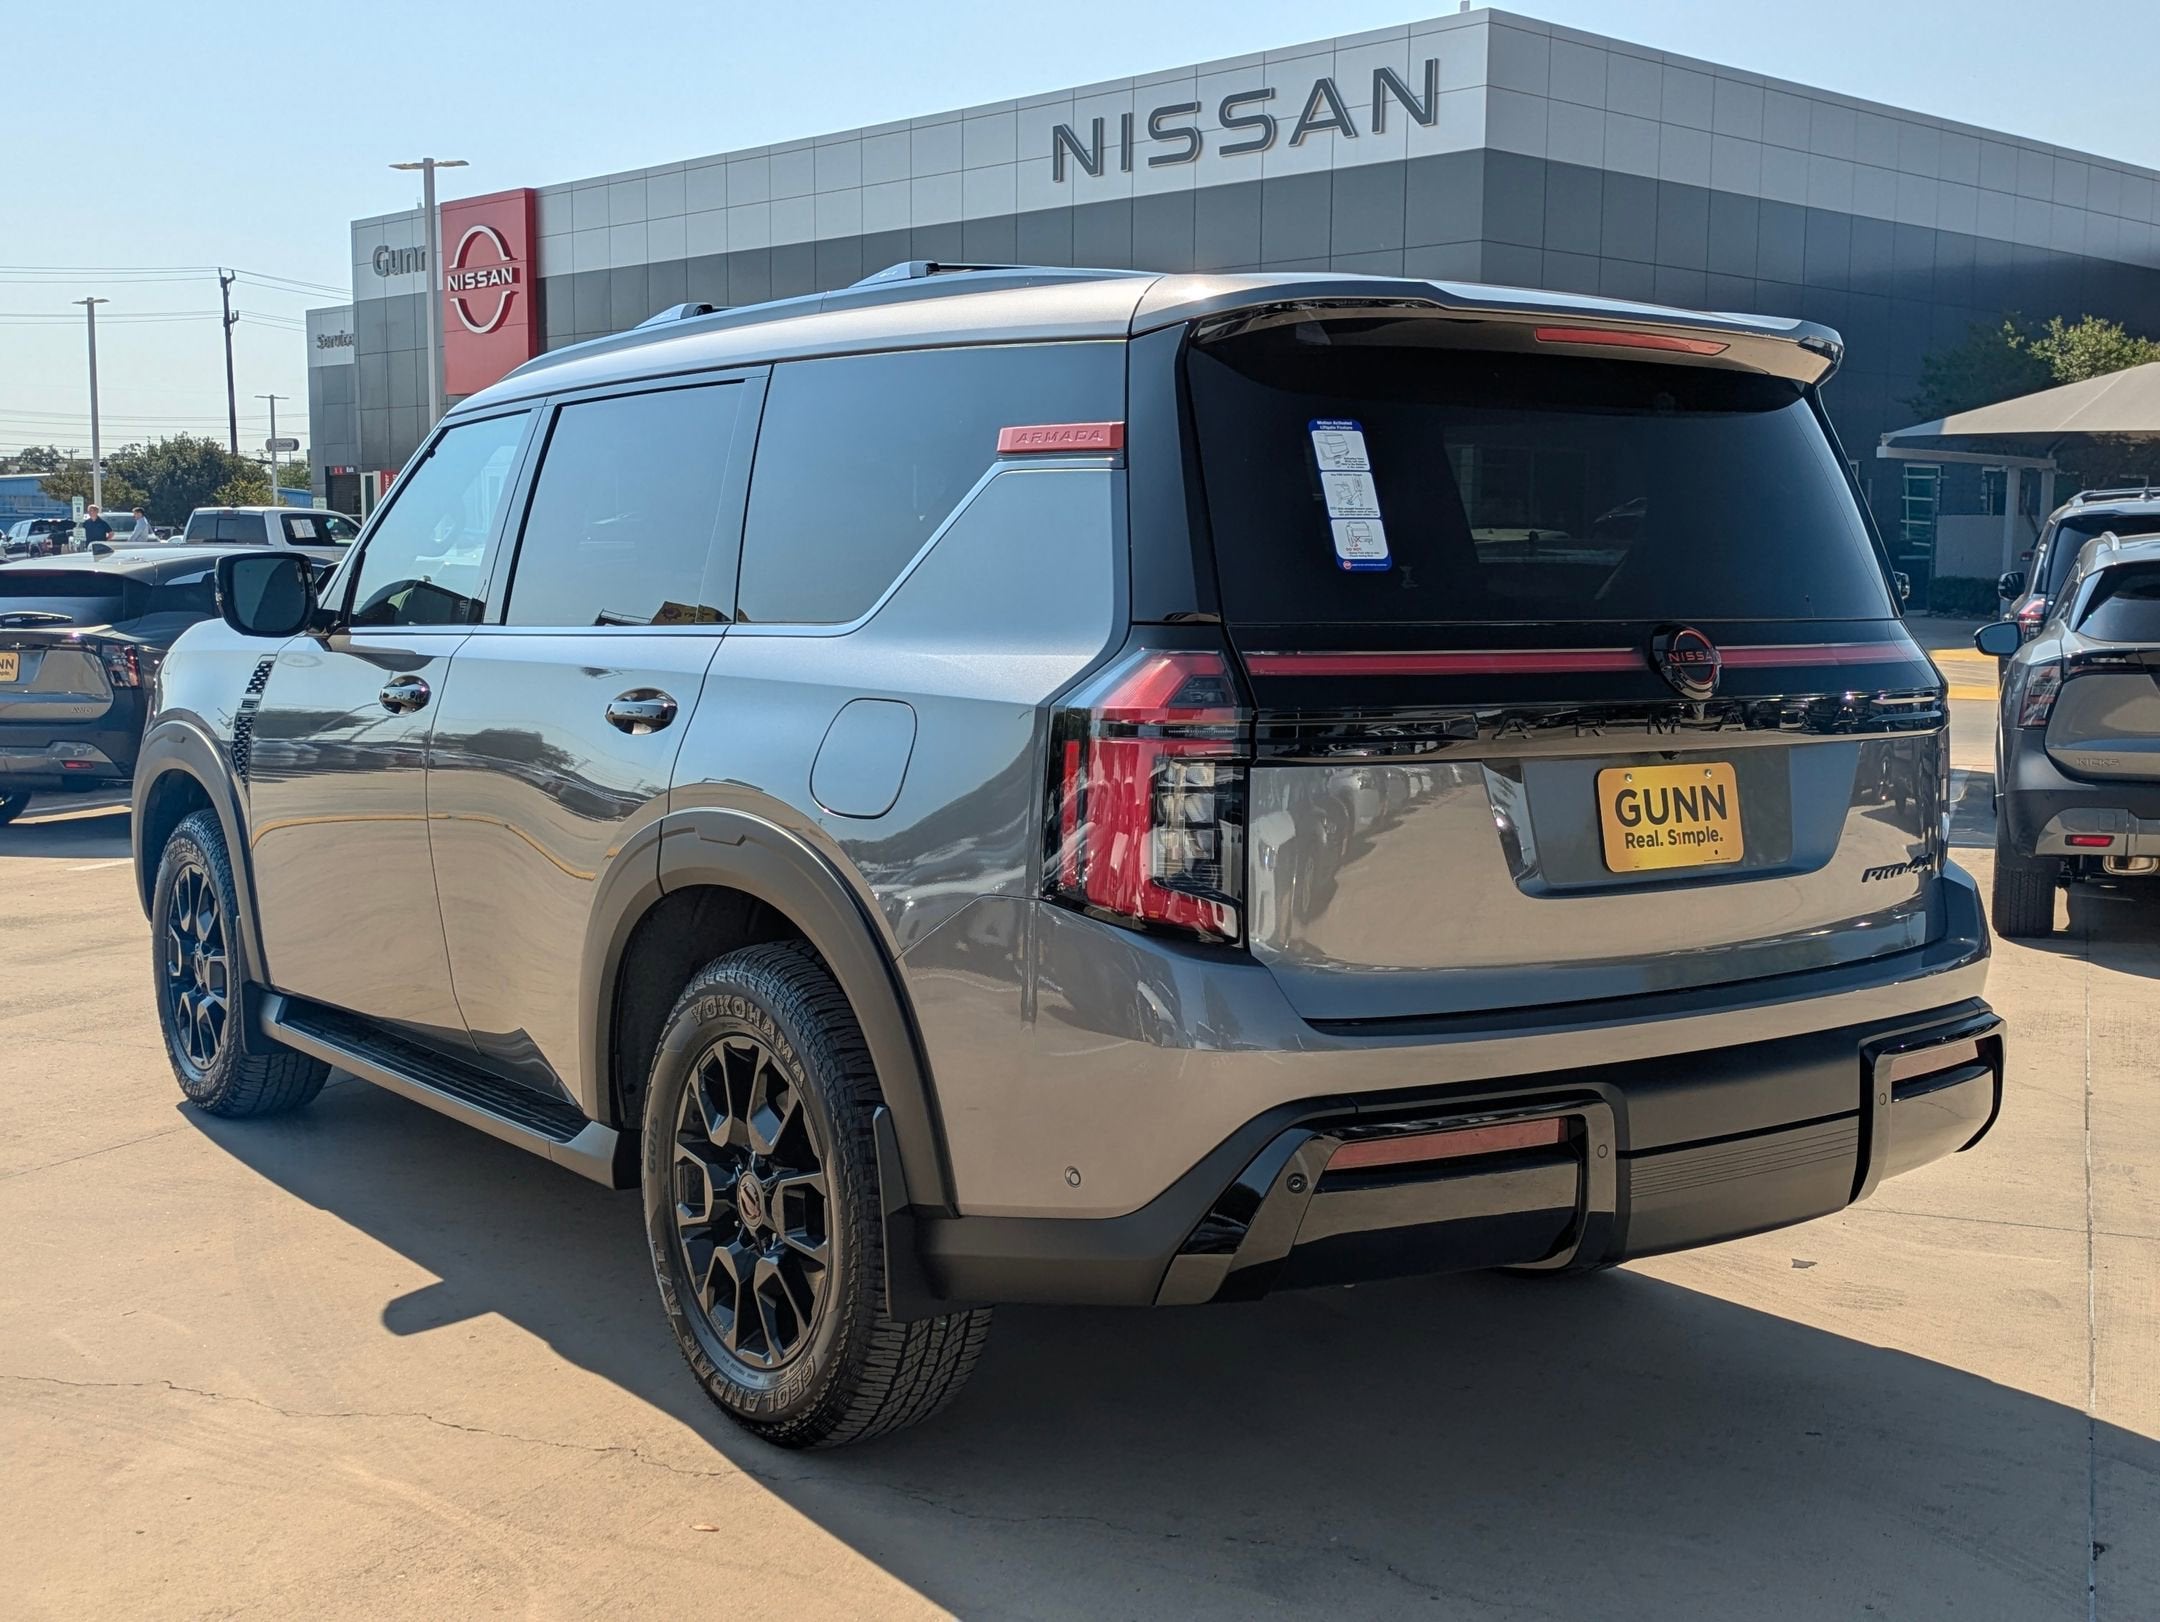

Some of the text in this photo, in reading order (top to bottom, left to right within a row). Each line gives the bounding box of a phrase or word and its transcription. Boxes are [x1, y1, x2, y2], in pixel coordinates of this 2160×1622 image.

[1051, 58, 1439, 183] NISSAN
[447, 267, 514, 291] NISSAN
[1015, 429, 1104, 445] ARMADA
[1667, 651, 1716, 663] NISSA
[2077, 757, 2121, 768] KICKS
[1615, 784, 1728, 828] GUNN
[1625, 830, 1664, 849] Real.
[690, 994, 806, 1088] YOKOHAMA
[682, 1330, 817, 1414] GEOLANDAR
